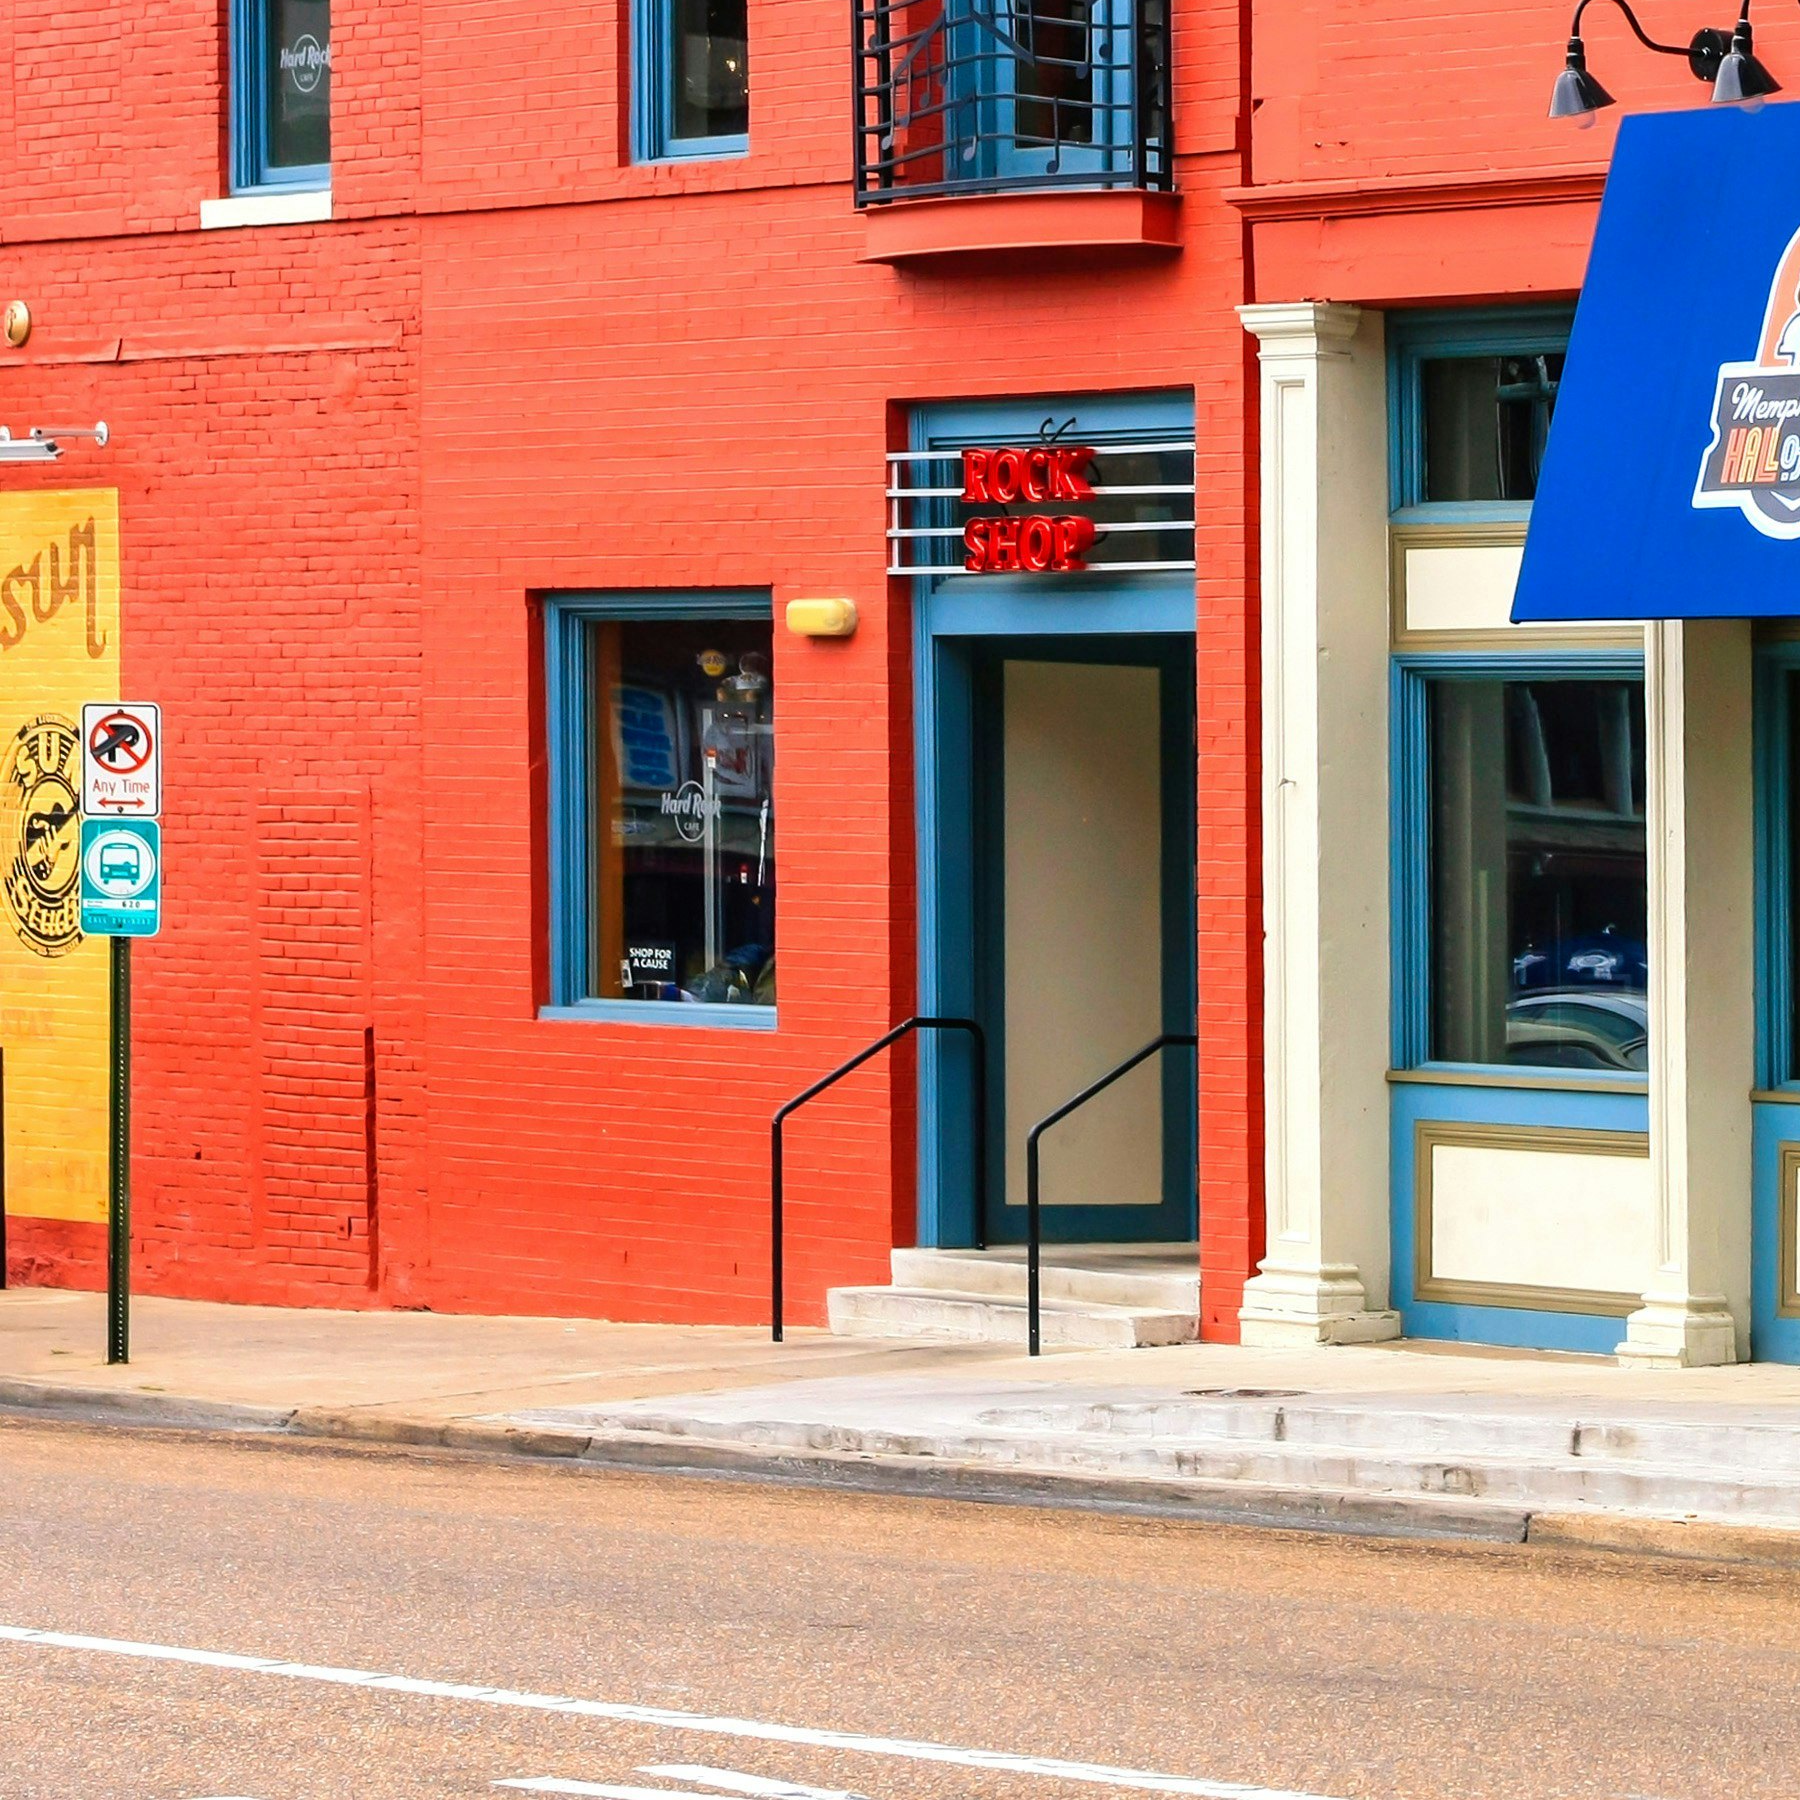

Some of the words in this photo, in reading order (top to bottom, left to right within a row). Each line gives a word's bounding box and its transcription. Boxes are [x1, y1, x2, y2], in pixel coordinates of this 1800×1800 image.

[280, 46, 306, 69] Hard
[1720, 427, 1780, 484] HALL
[961, 447, 1097, 503] ROCK
[964, 515, 1095, 572] SHOP
[93, 778, 116, 796] Any
[119, 778, 150, 794] Time
[661, 792, 691, 815] Hard
[11, 873, 80, 936] Studi
[629, 948, 654, 958] SHOP
[655, 949, 672, 960] FOR
[633, 958, 640, 968] A
[640, 959, 668, 970] CAUSE
